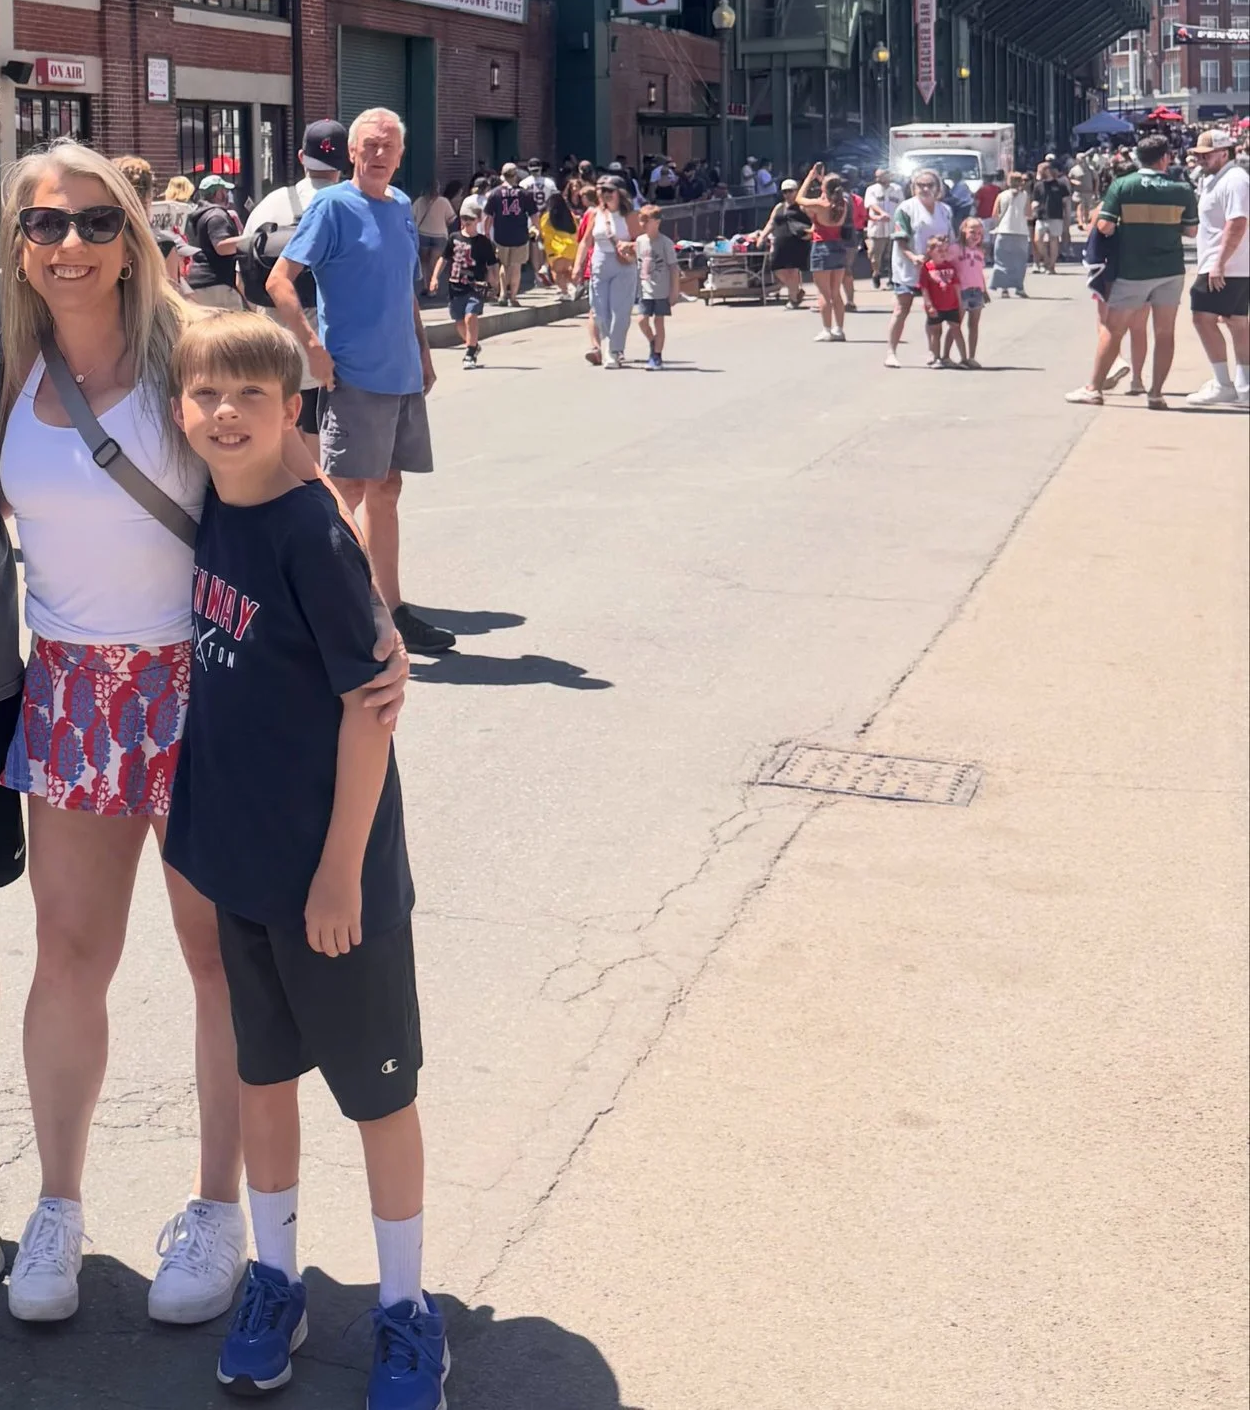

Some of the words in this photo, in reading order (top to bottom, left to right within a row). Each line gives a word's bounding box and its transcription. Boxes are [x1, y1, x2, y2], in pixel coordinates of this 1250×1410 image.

[494, 0, 522, 14] STREET
[920, 2, 931, 24] BAR
[920, 27, 932, 83] BLEACHER
[50, 64, 64, 78] ON
[66, 66, 83, 80] AIR
[502, 198, 522, 216] 14
[193, 565, 261, 641] NWAY
